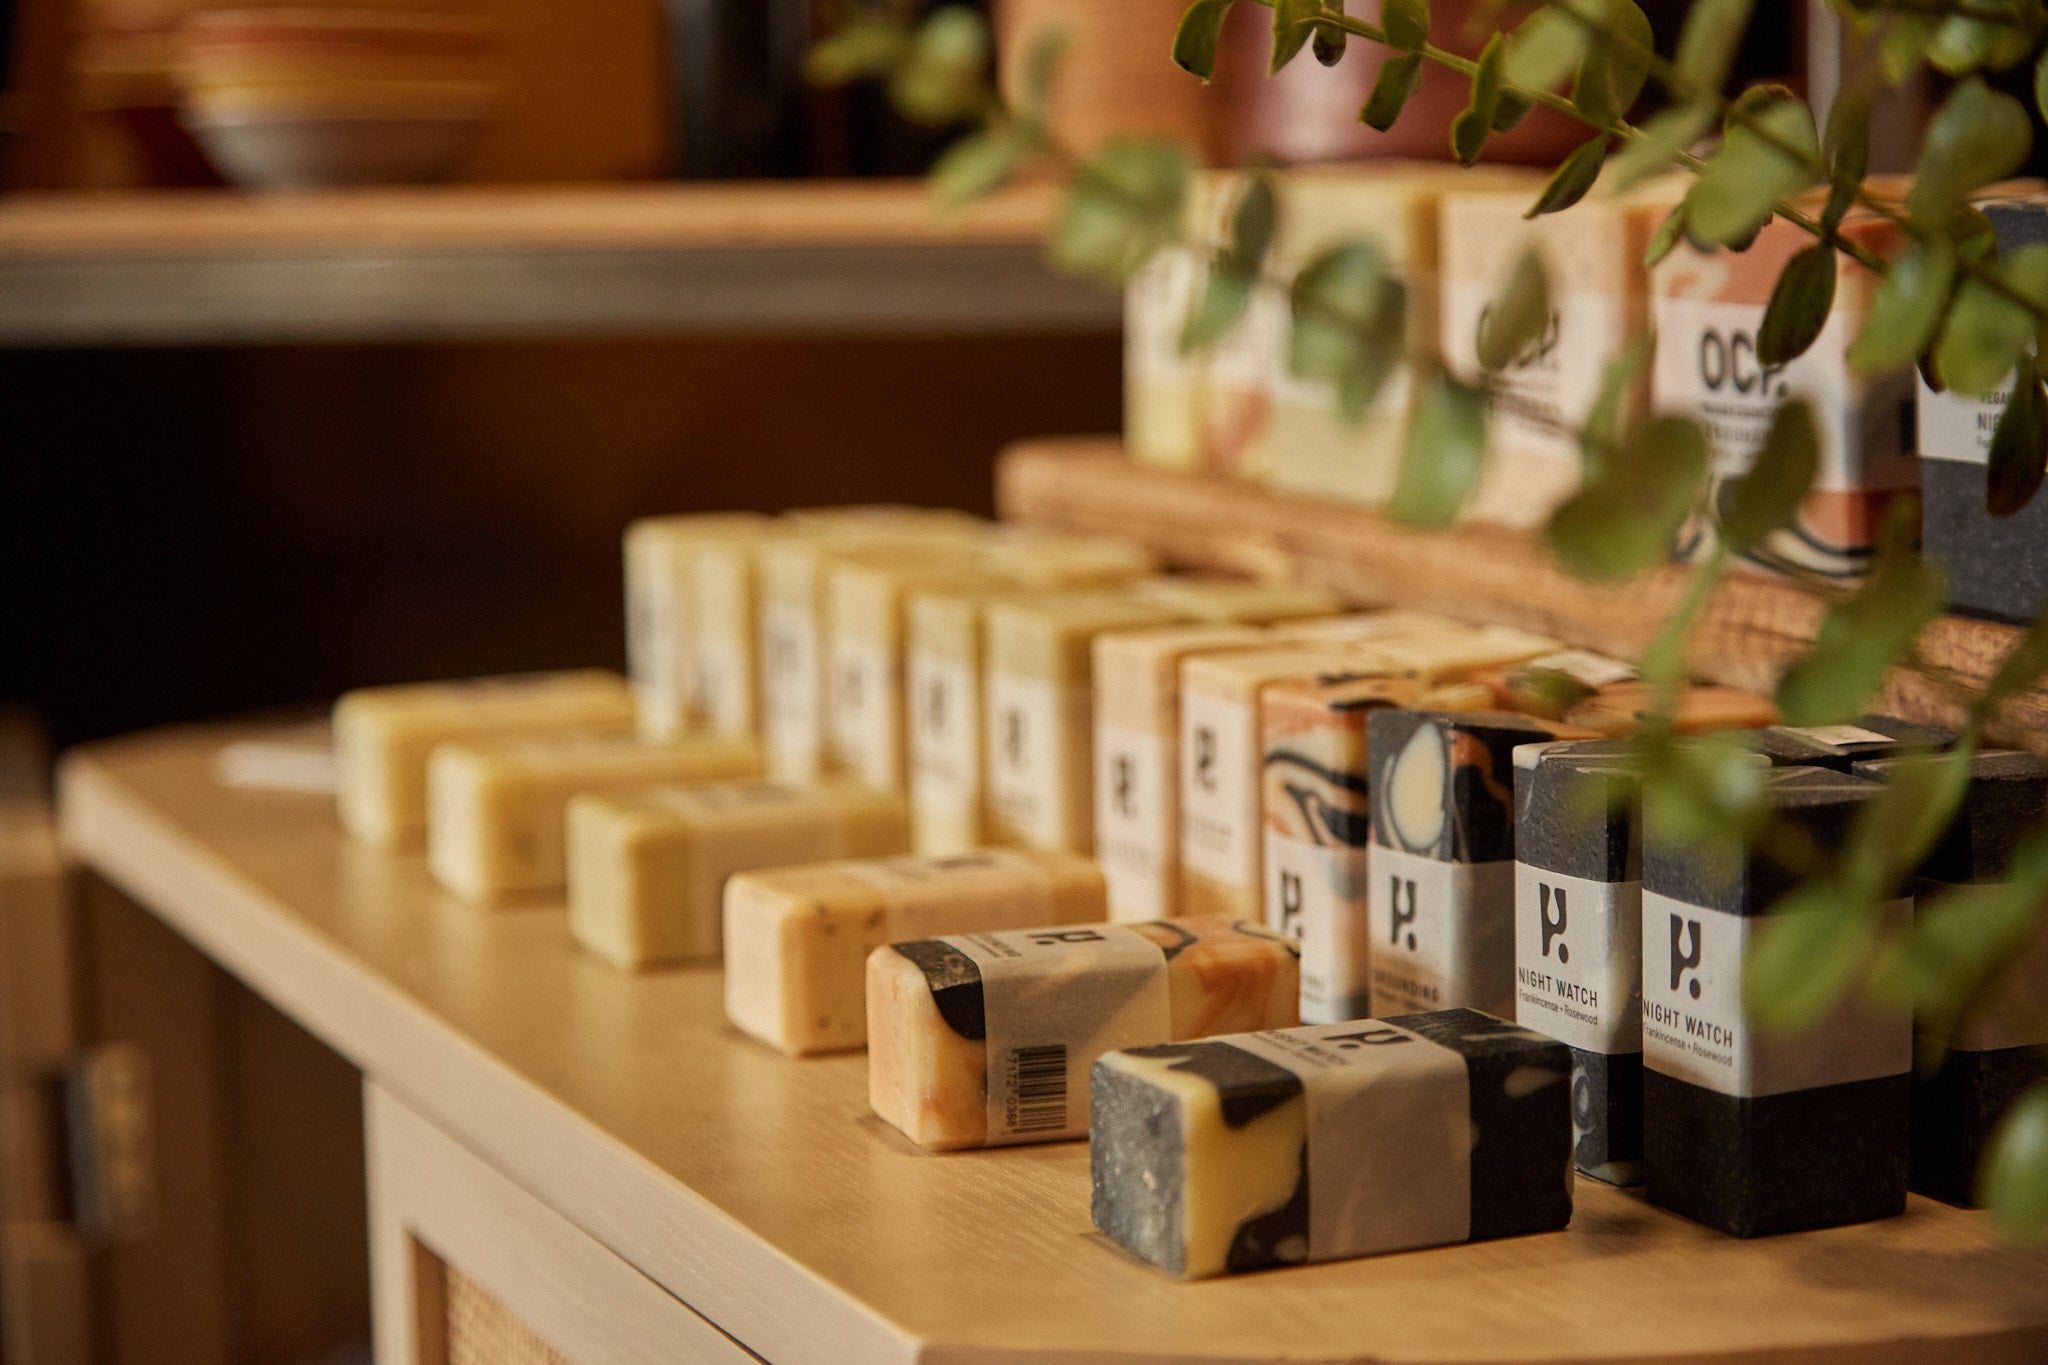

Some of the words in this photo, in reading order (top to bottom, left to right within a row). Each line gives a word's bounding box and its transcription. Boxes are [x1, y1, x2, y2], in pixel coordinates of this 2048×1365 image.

[1518, 966, 1551, 993] NIGHT
[1556, 979, 1599, 1008] WATCH
[1519, 988, 1559, 1012] Frankincense
[1564, 1003, 1599, 1027] Rosewood
[1642, 998, 1680, 1029] NIGHT
[1685, 1015, 1733, 1049] WATCH
[1006, 1056, 1018, 1089] 7172
[1692, 1041, 1734, 1066] Rosewood
